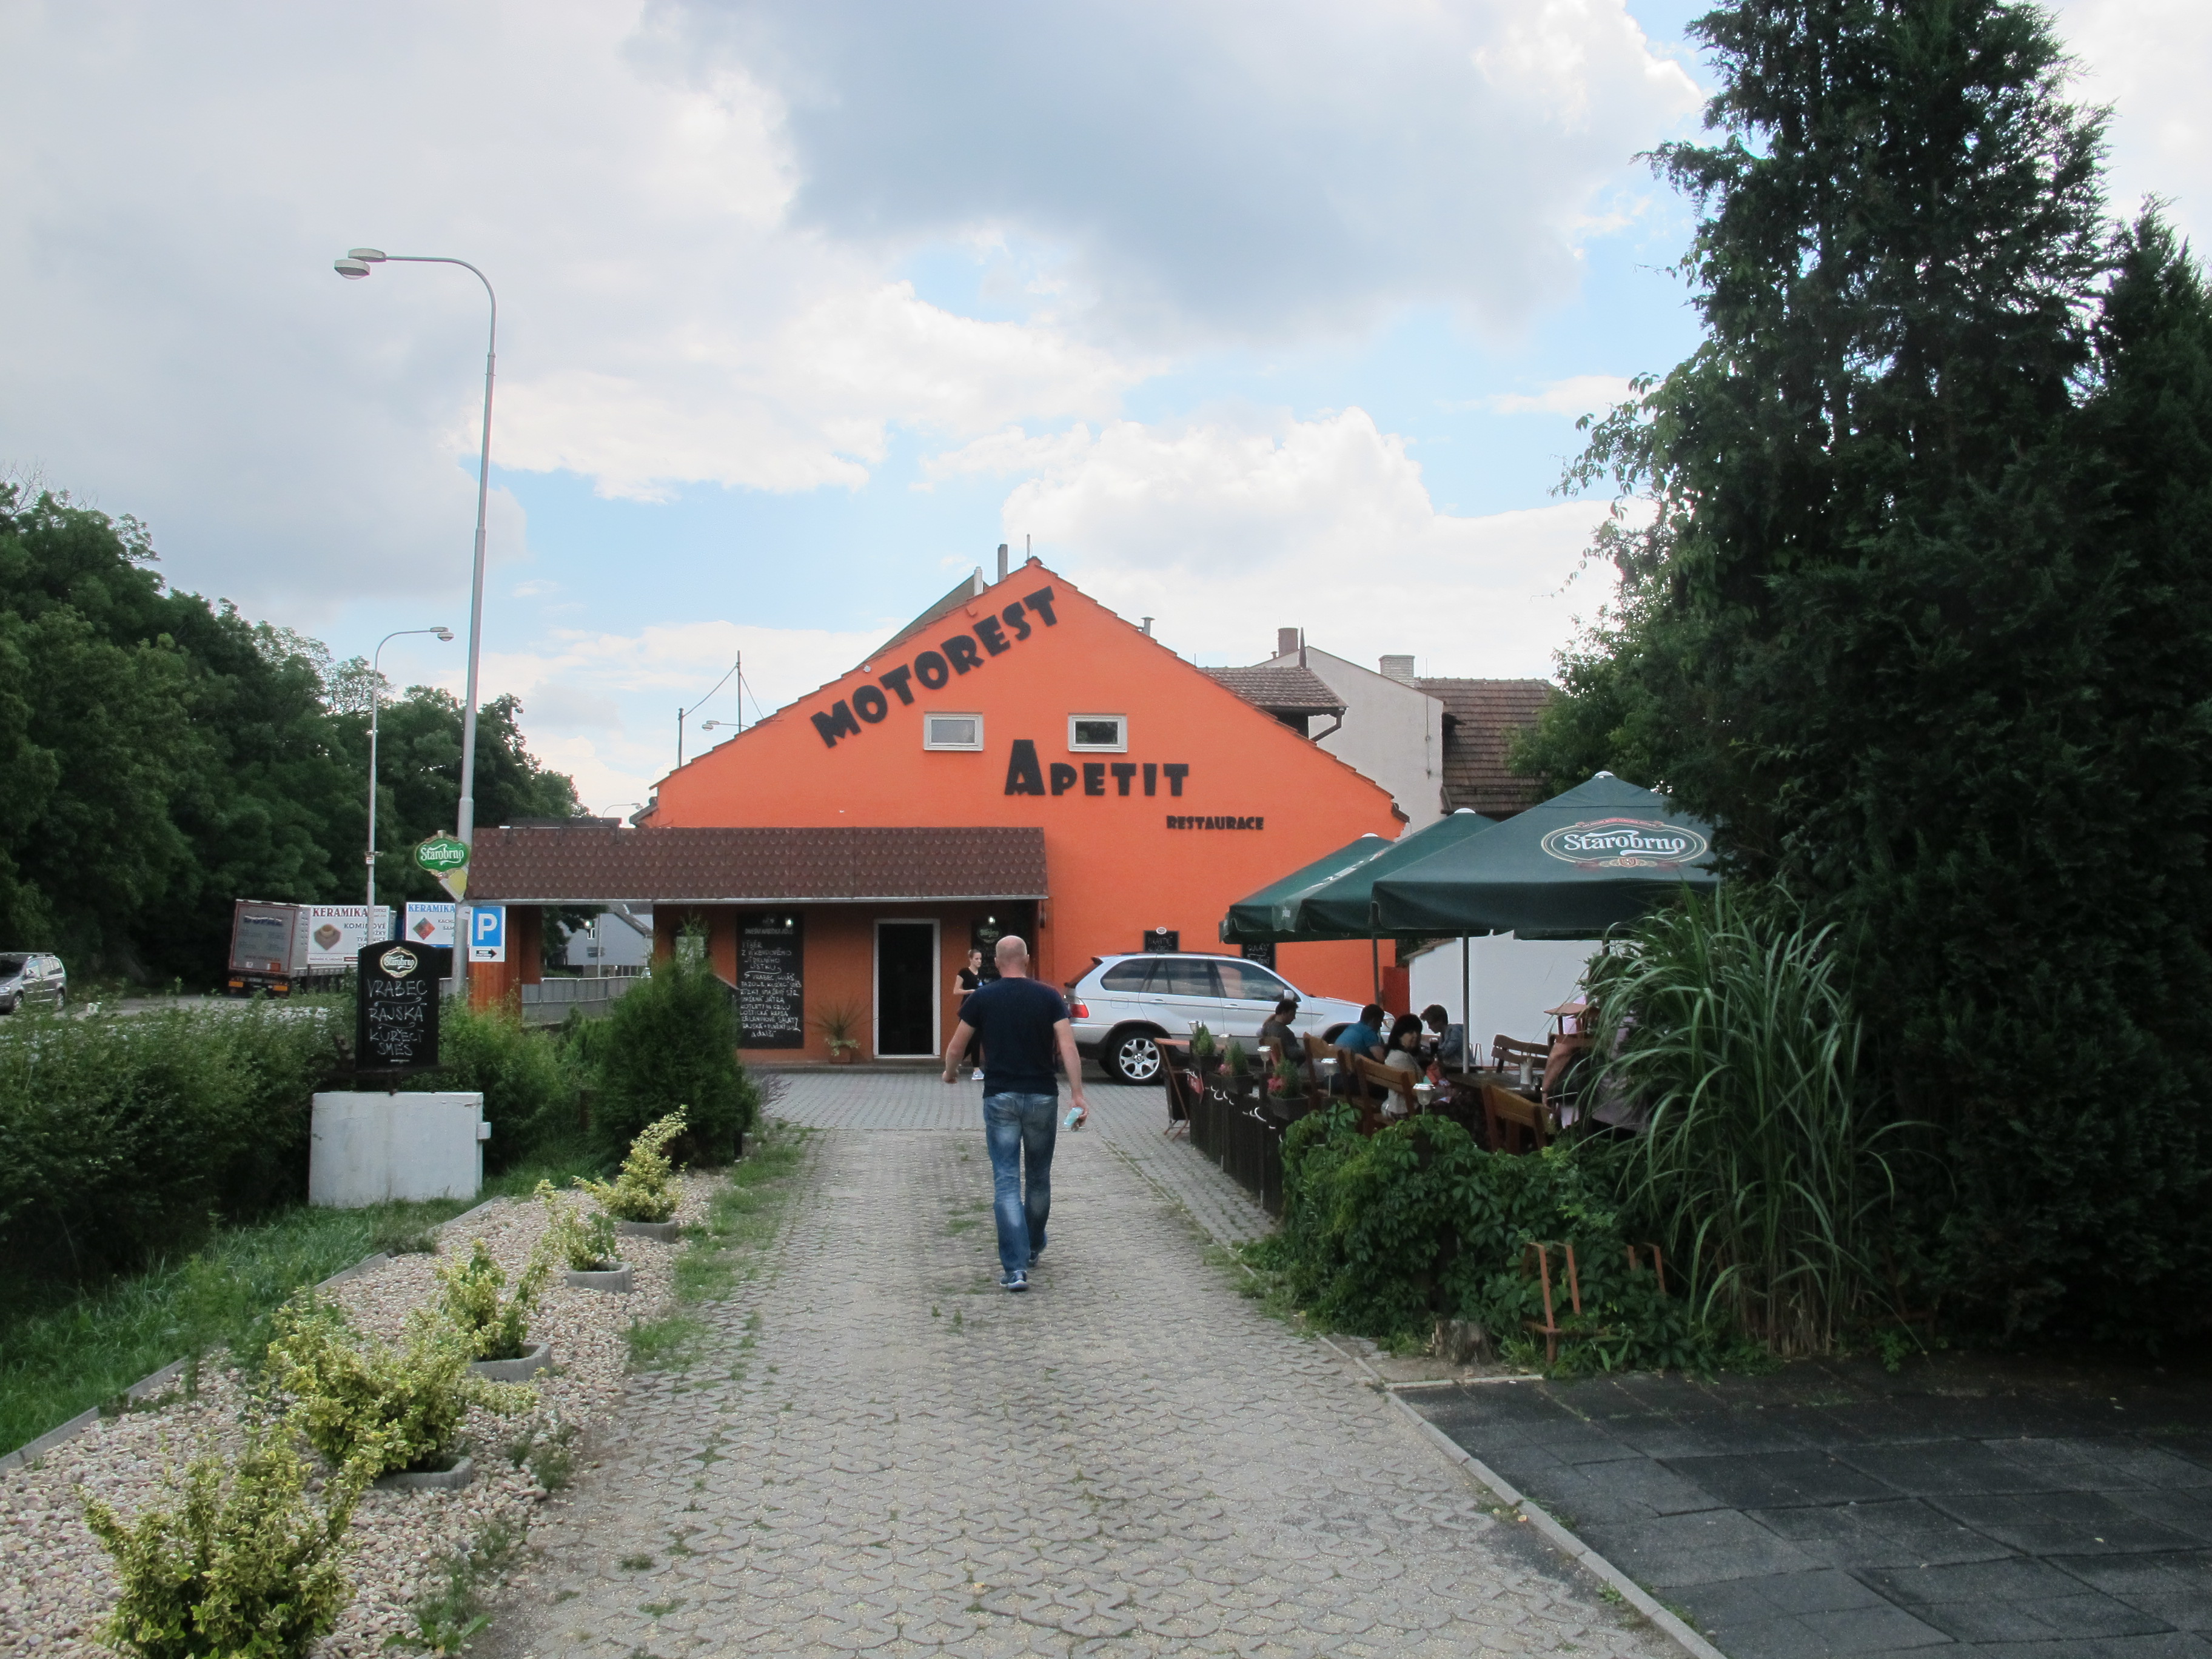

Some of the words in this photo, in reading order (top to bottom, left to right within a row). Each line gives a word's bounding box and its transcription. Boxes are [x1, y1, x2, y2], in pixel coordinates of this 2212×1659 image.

[811, 586, 1058, 748] MOTOREST
[1167, 815, 1265, 831] RESTAURACE
[1564, 830, 1686, 856] Starobrno
[420, 843, 464, 866] Starobrno
[313, 908, 368, 917] KERAMIKA
[477, 913, 498, 940] P
[367, 979, 427, 997] VRABEC
[369, 1002, 427, 1022] RAJSKÁ
[369, 1028, 424, 1042] KUŘECÍ
[377, 1042, 413, 1056] SMĚS
